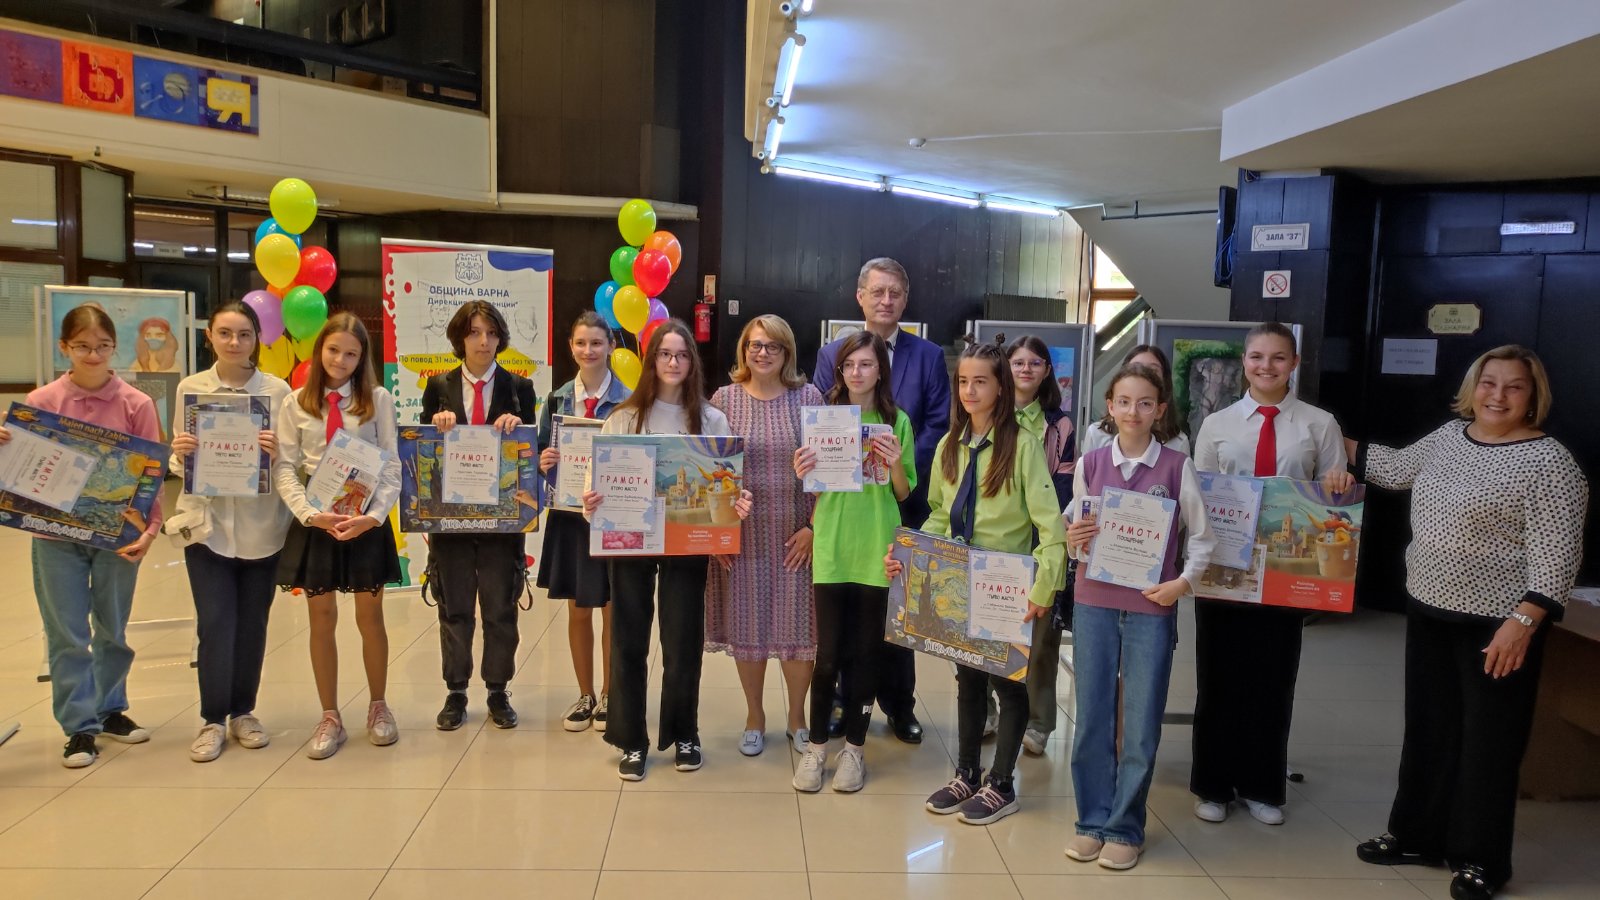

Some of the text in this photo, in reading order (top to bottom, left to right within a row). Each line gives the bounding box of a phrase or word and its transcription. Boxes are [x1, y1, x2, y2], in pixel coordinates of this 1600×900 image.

[1265, 232, 1302, 241] ЗАЛА "37"
[429, 285, 510, 298] ОБЩИНА ВАРНА
[410, 356, 433, 364] повод
[807, 436, 855, 445] ГРАМОТА
[202, 441, 254, 452] ГРАМОТА
[449, 452, 495, 463] ГРАМОТА
[31, 448, 64, 494] ГРАМОТА
[600, 474, 649, 486] ГРАМОТА
[1103, 520, 1161, 541] ГРАМОТА
[975, 582, 1027, 596] ГРАМОТА
